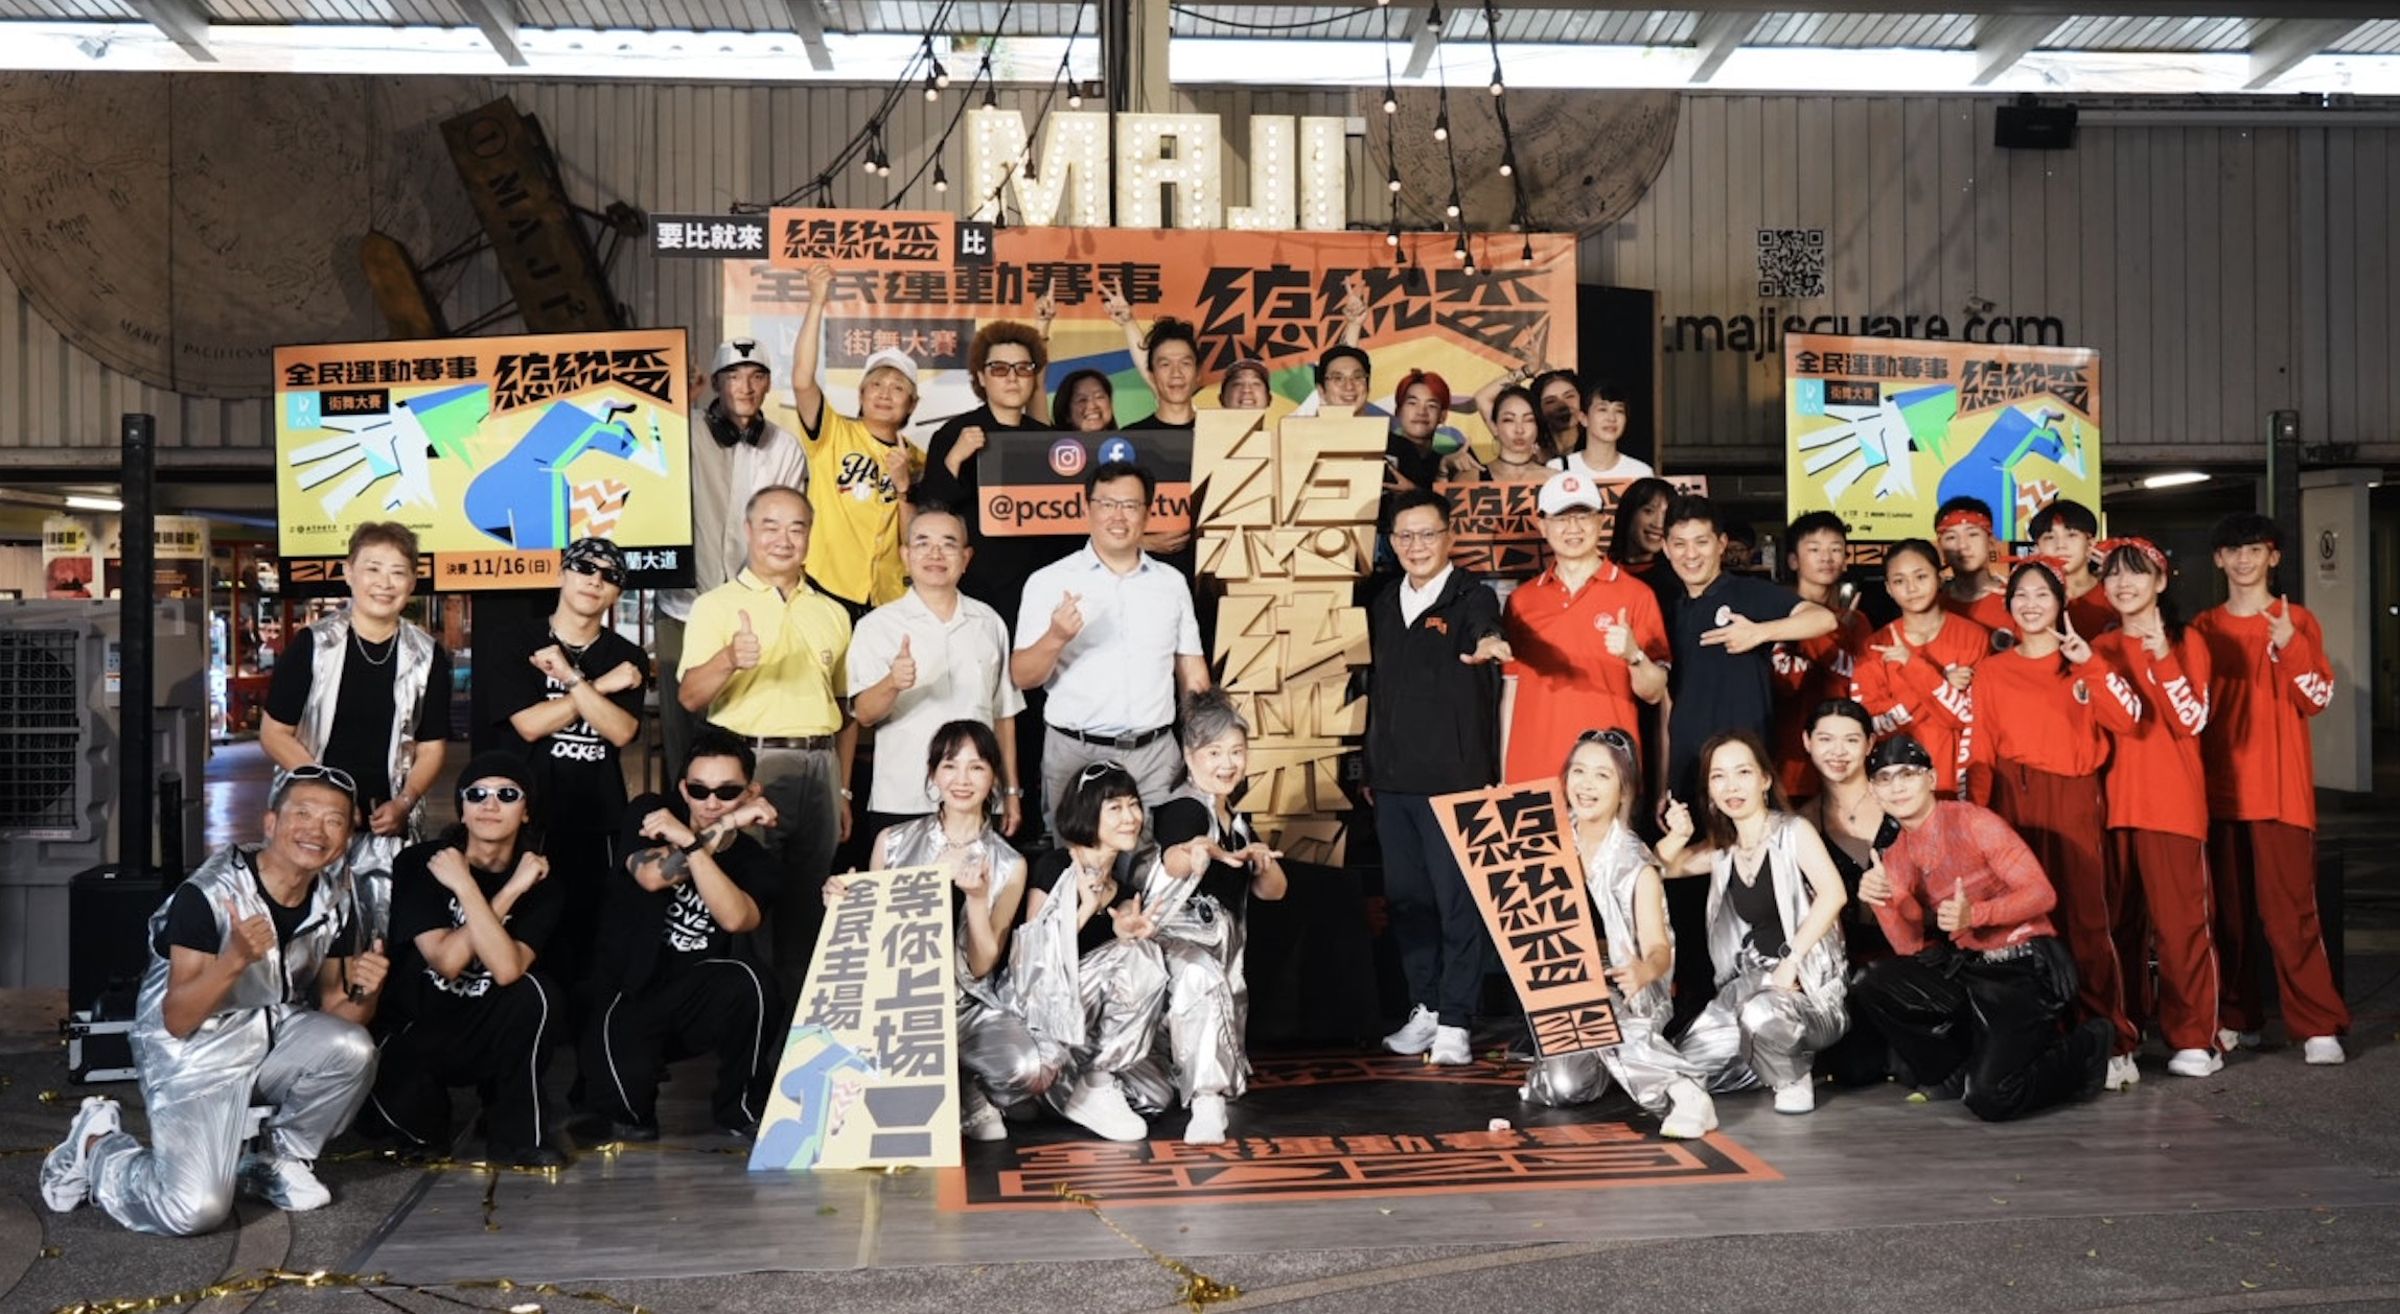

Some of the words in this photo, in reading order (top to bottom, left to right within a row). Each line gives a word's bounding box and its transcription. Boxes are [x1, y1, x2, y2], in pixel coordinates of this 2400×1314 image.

[968, 110, 1346, 231] MAJI
[656, 222, 763, 251] 要比就來
[783, 219, 940, 261] 總統盃
[962, 229, 986, 256] 比
[750, 260, 1162, 306] 全民運動賽事
[1196, 264, 1552, 374] 總統盃
[844, 329, 957, 358] 街舞大賽
[1795, 351, 1949, 380] 全民運動賽事
[285, 357, 478, 386] 全民運動賽事
[493, 347, 673, 413] 總統盃
[1960, 359, 2090, 416] 總統盃
[328, 393, 384, 412] 街舞大賽
[446, 562, 468, 576] 決賽
[473, 556, 525, 578] 11/16
[1453, 789, 1592, 991] 總統盃
[804, 878, 881, 1032] 全民主場
